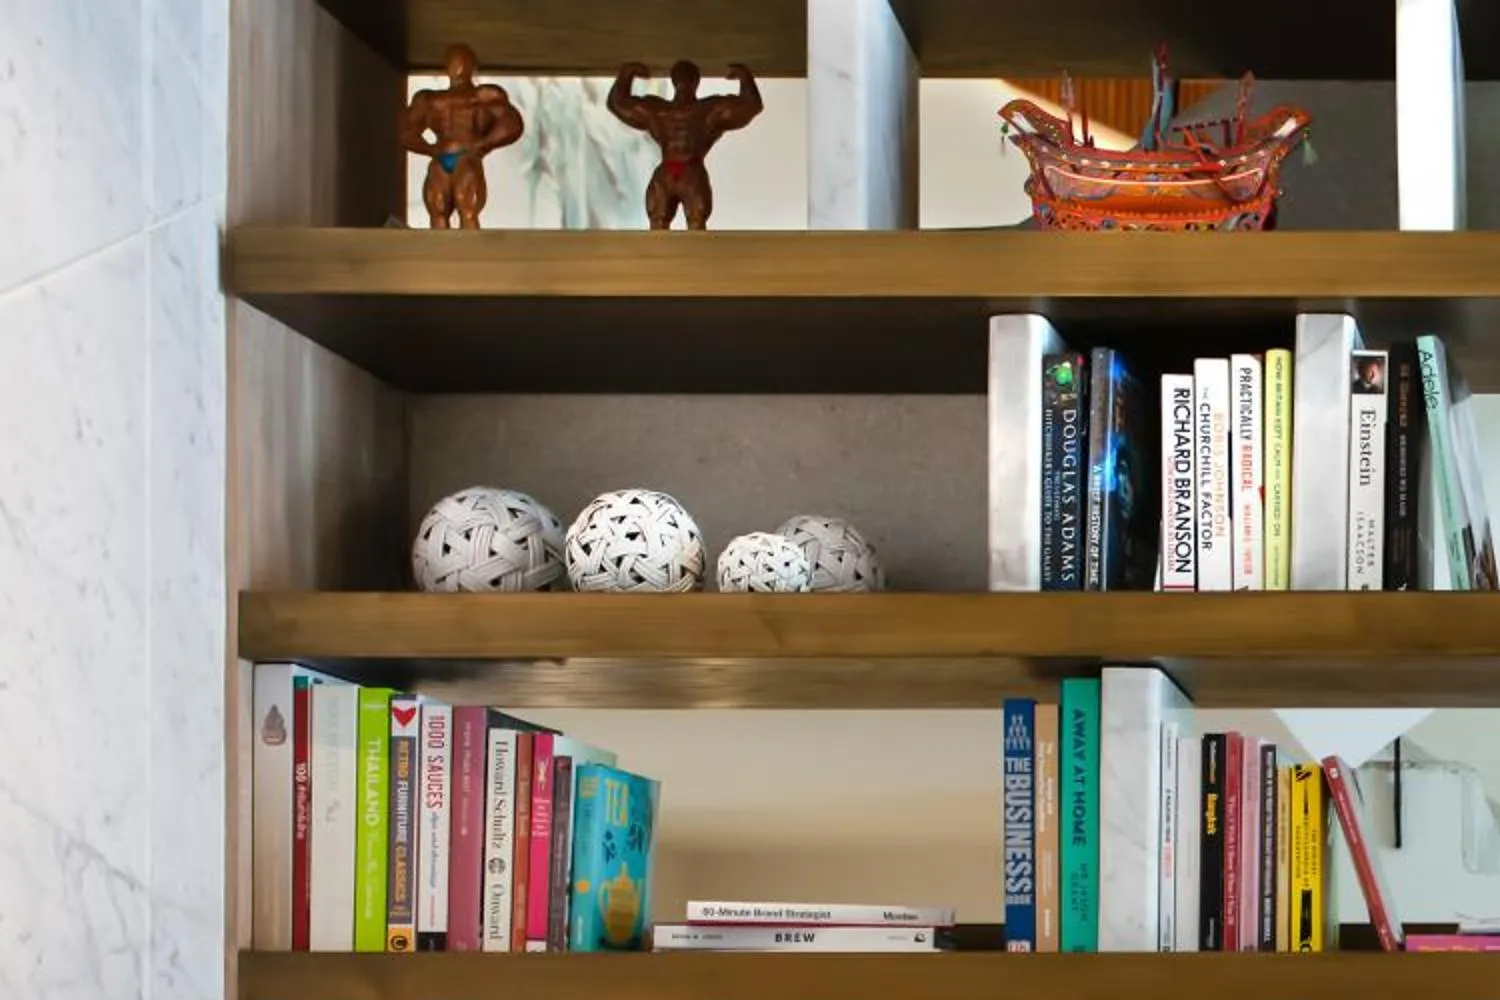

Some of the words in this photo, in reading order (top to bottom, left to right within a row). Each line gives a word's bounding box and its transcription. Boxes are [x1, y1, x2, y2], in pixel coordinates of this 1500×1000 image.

[1240, 367, 1252, 440] PRACTICALLY
[1418, 350, 1440, 410] Adele
[1062, 408, 1077, 505] DOUGLAS
[1174, 387, 1191, 474] RICHARD
[1200, 403, 1212, 487] CHURCHILL
[1213, 412, 1226, 456] BORIS
[1359, 409, 1377, 486] Einstein
[1241, 445, 1252, 492] RADICAL
[1091, 504, 1101, 543] HISTORY
[1174, 478, 1192, 573] BRANSON
[1201, 492, 1213, 551] FACTOR
[1214, 461, 1226, 537] JOHNSON
[1062, 513, 1076, 582] ADAMS
[1355, 511, 1365, 574] ISAACSON
[427, 715, 444, 748] 1000
[1071, 708, 1087, 761] AWAY
[365, 737, 381, 826] THAILAND
[426, 755, 444, 809] SAUCES
[494, 741, 509, 796] Howard
[1072, 765, 1086, 784] AT
[396, 780, 410, 841] FURNITURE
[491, 798, 507, 849] Schultz
[604, 777, 629, 829] TEA
[1072, 791, 1087, 846] HOME
[1005, 774, 1032, 893] BUSINESS
[490, 884, 505, 940] Onward
[775, 933, 815, 942] BREW
